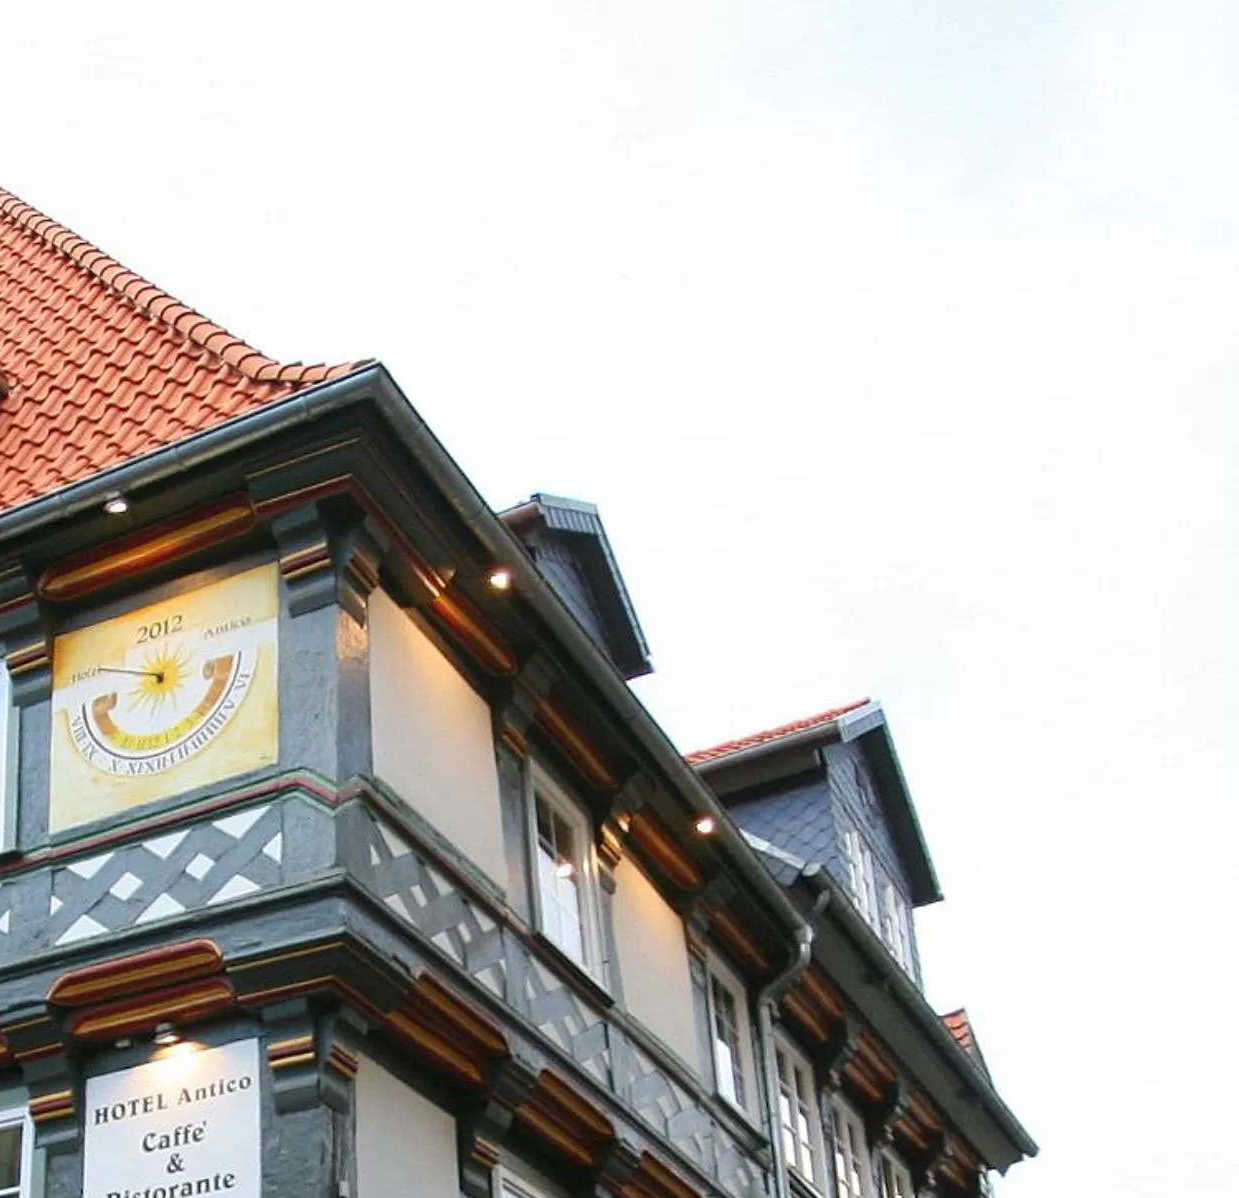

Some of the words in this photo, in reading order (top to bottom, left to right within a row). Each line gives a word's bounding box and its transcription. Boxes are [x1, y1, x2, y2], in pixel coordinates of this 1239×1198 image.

[136, 614, 184, 643] 2012
[94, 1093, 169, 1126] HOTEL
[177, 1075, 252, 1104] Antico
[166, 1152, 185, 1175] &
